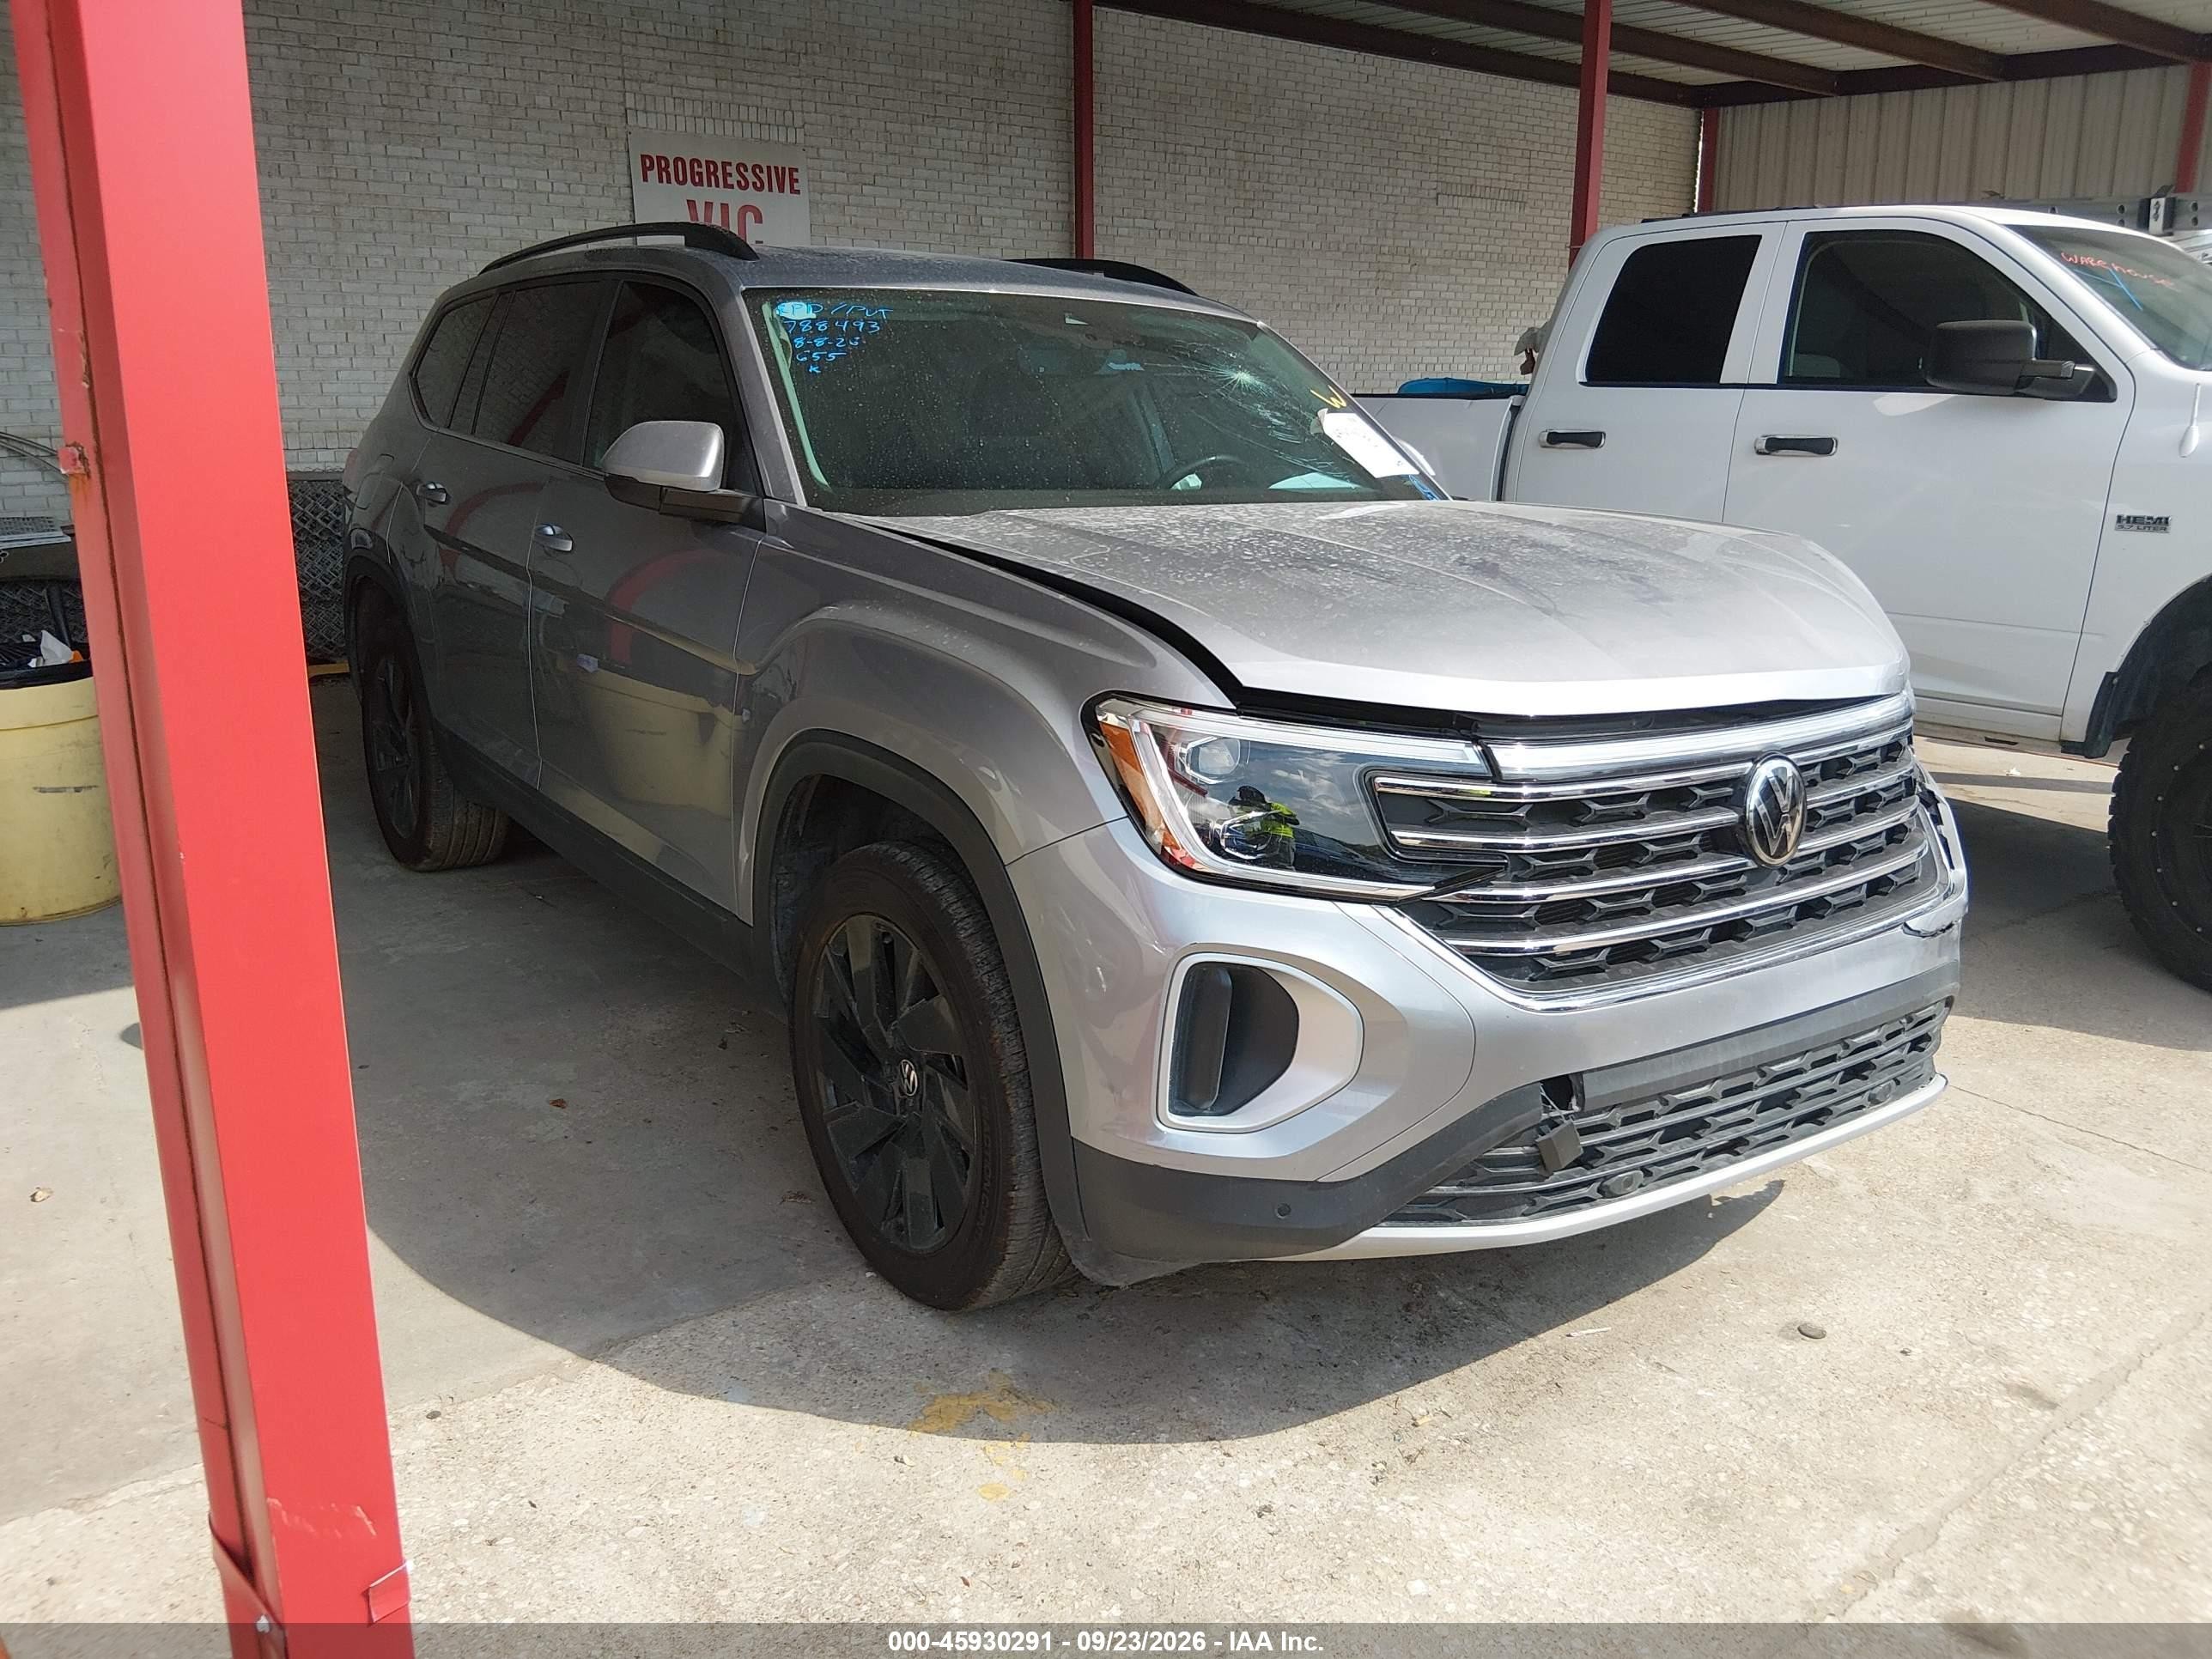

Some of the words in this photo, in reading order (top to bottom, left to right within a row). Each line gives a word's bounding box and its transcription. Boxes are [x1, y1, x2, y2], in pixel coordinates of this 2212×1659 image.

[640, 154, 800, 196] PROGRESSIVE
[783, 319, 880, 334] 788493
[2117, 515, 2171, 526] HEMI
